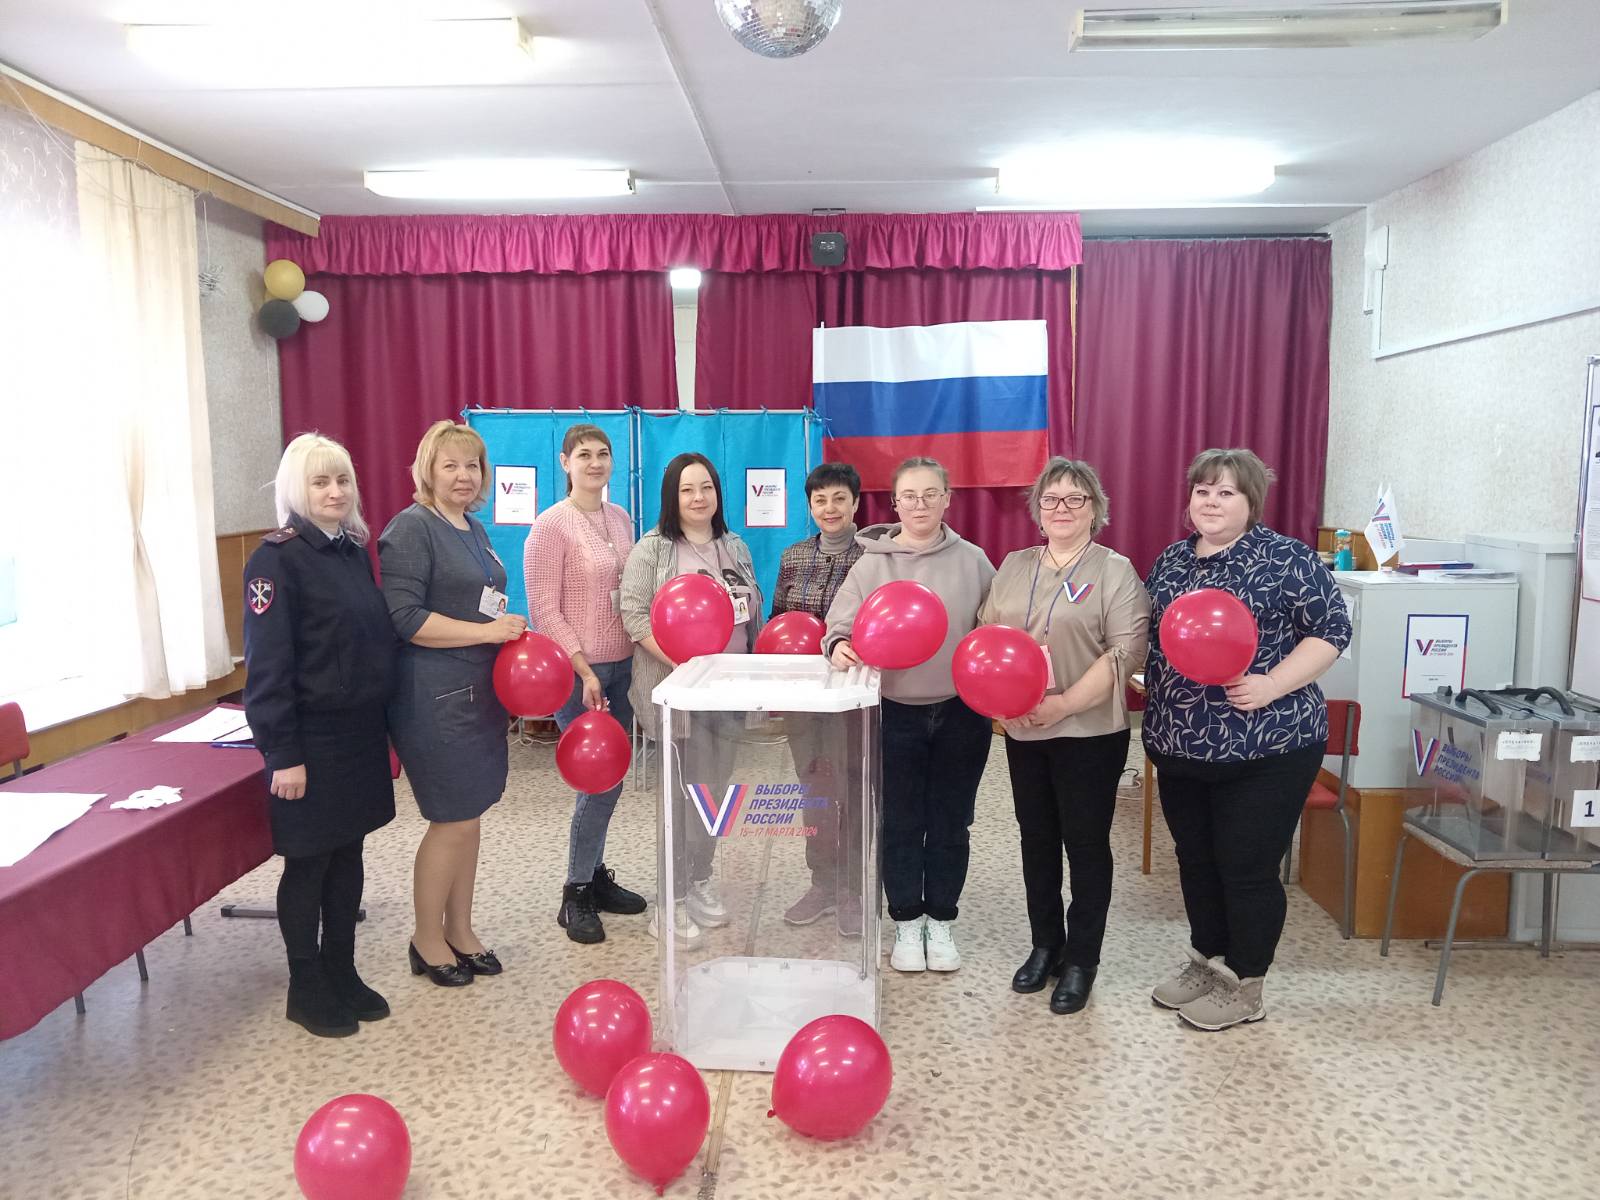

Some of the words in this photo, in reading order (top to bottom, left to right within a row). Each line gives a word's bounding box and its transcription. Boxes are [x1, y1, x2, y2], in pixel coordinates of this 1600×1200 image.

[748, 798, 829, 811] ПРЕЗИДЕ
[1584, 800, 1595, 818] 1
[743, 813, 794, 825] РОССИИ
[764, 826, 793, 837] МАРТА
